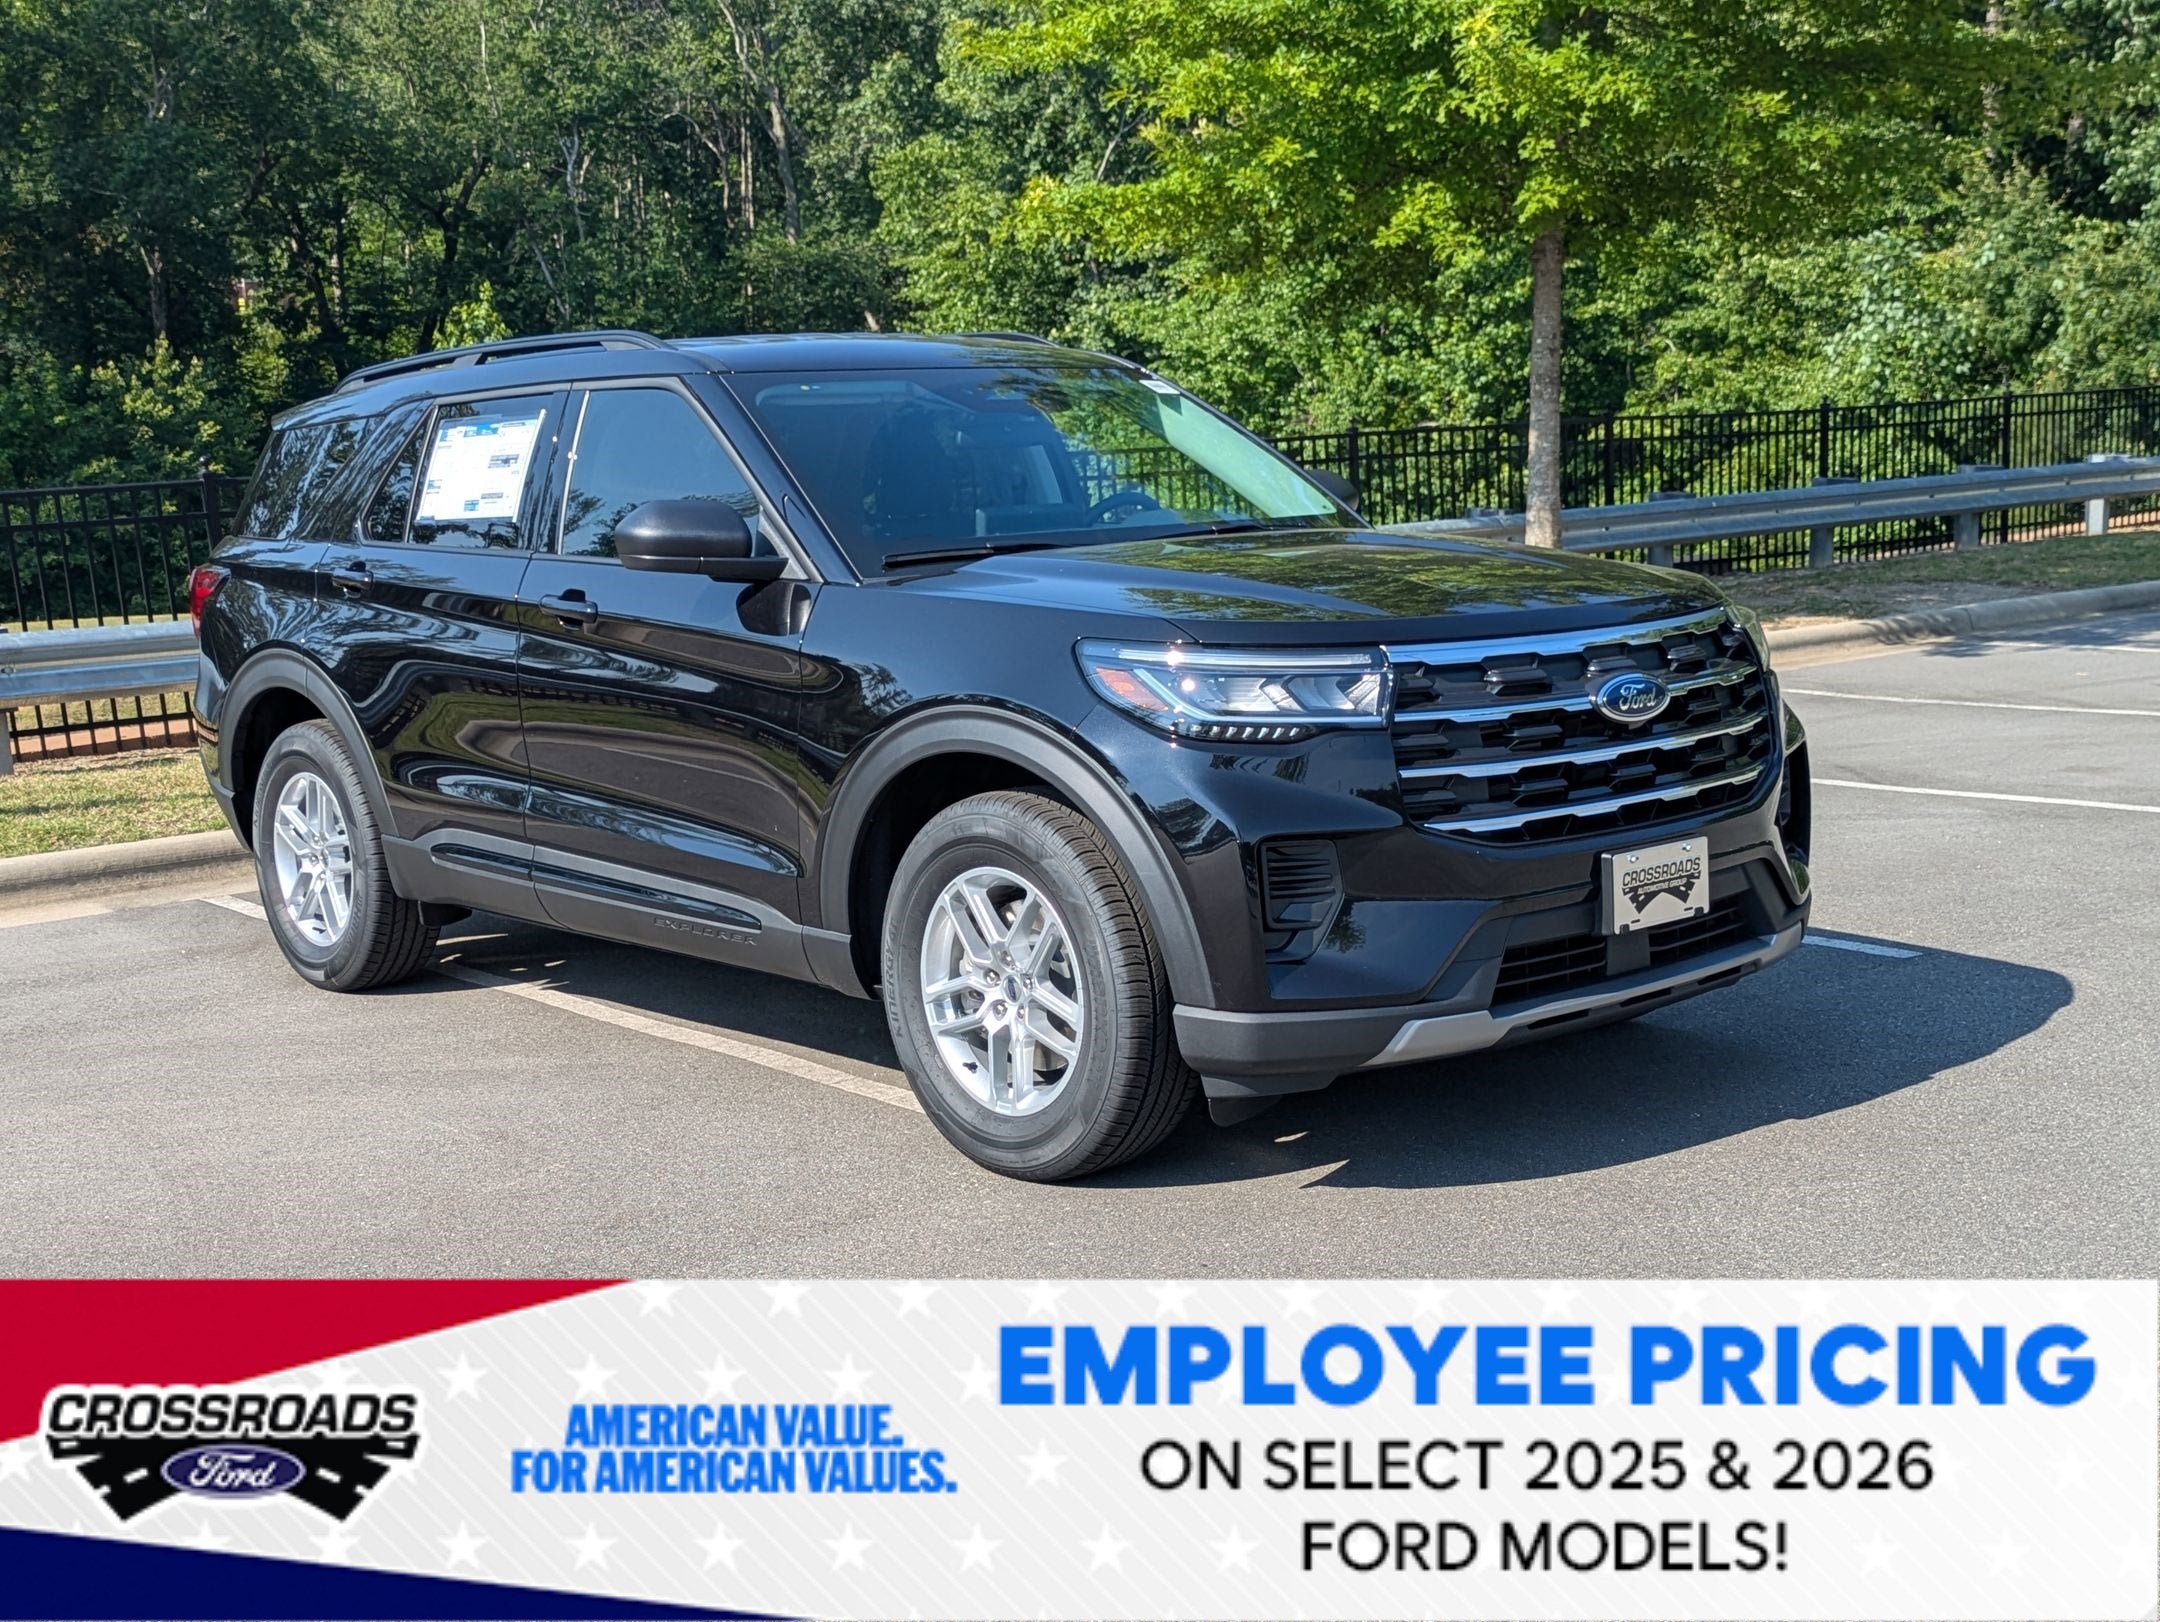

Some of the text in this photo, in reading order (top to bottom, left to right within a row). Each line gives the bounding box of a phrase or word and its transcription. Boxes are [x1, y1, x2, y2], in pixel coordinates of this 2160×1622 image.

[1619, 683, 1657, 711] Ford
[1622, 857, 1701, 887] CROSSROADS
[653, 917, 757, 946] EXPLORER
